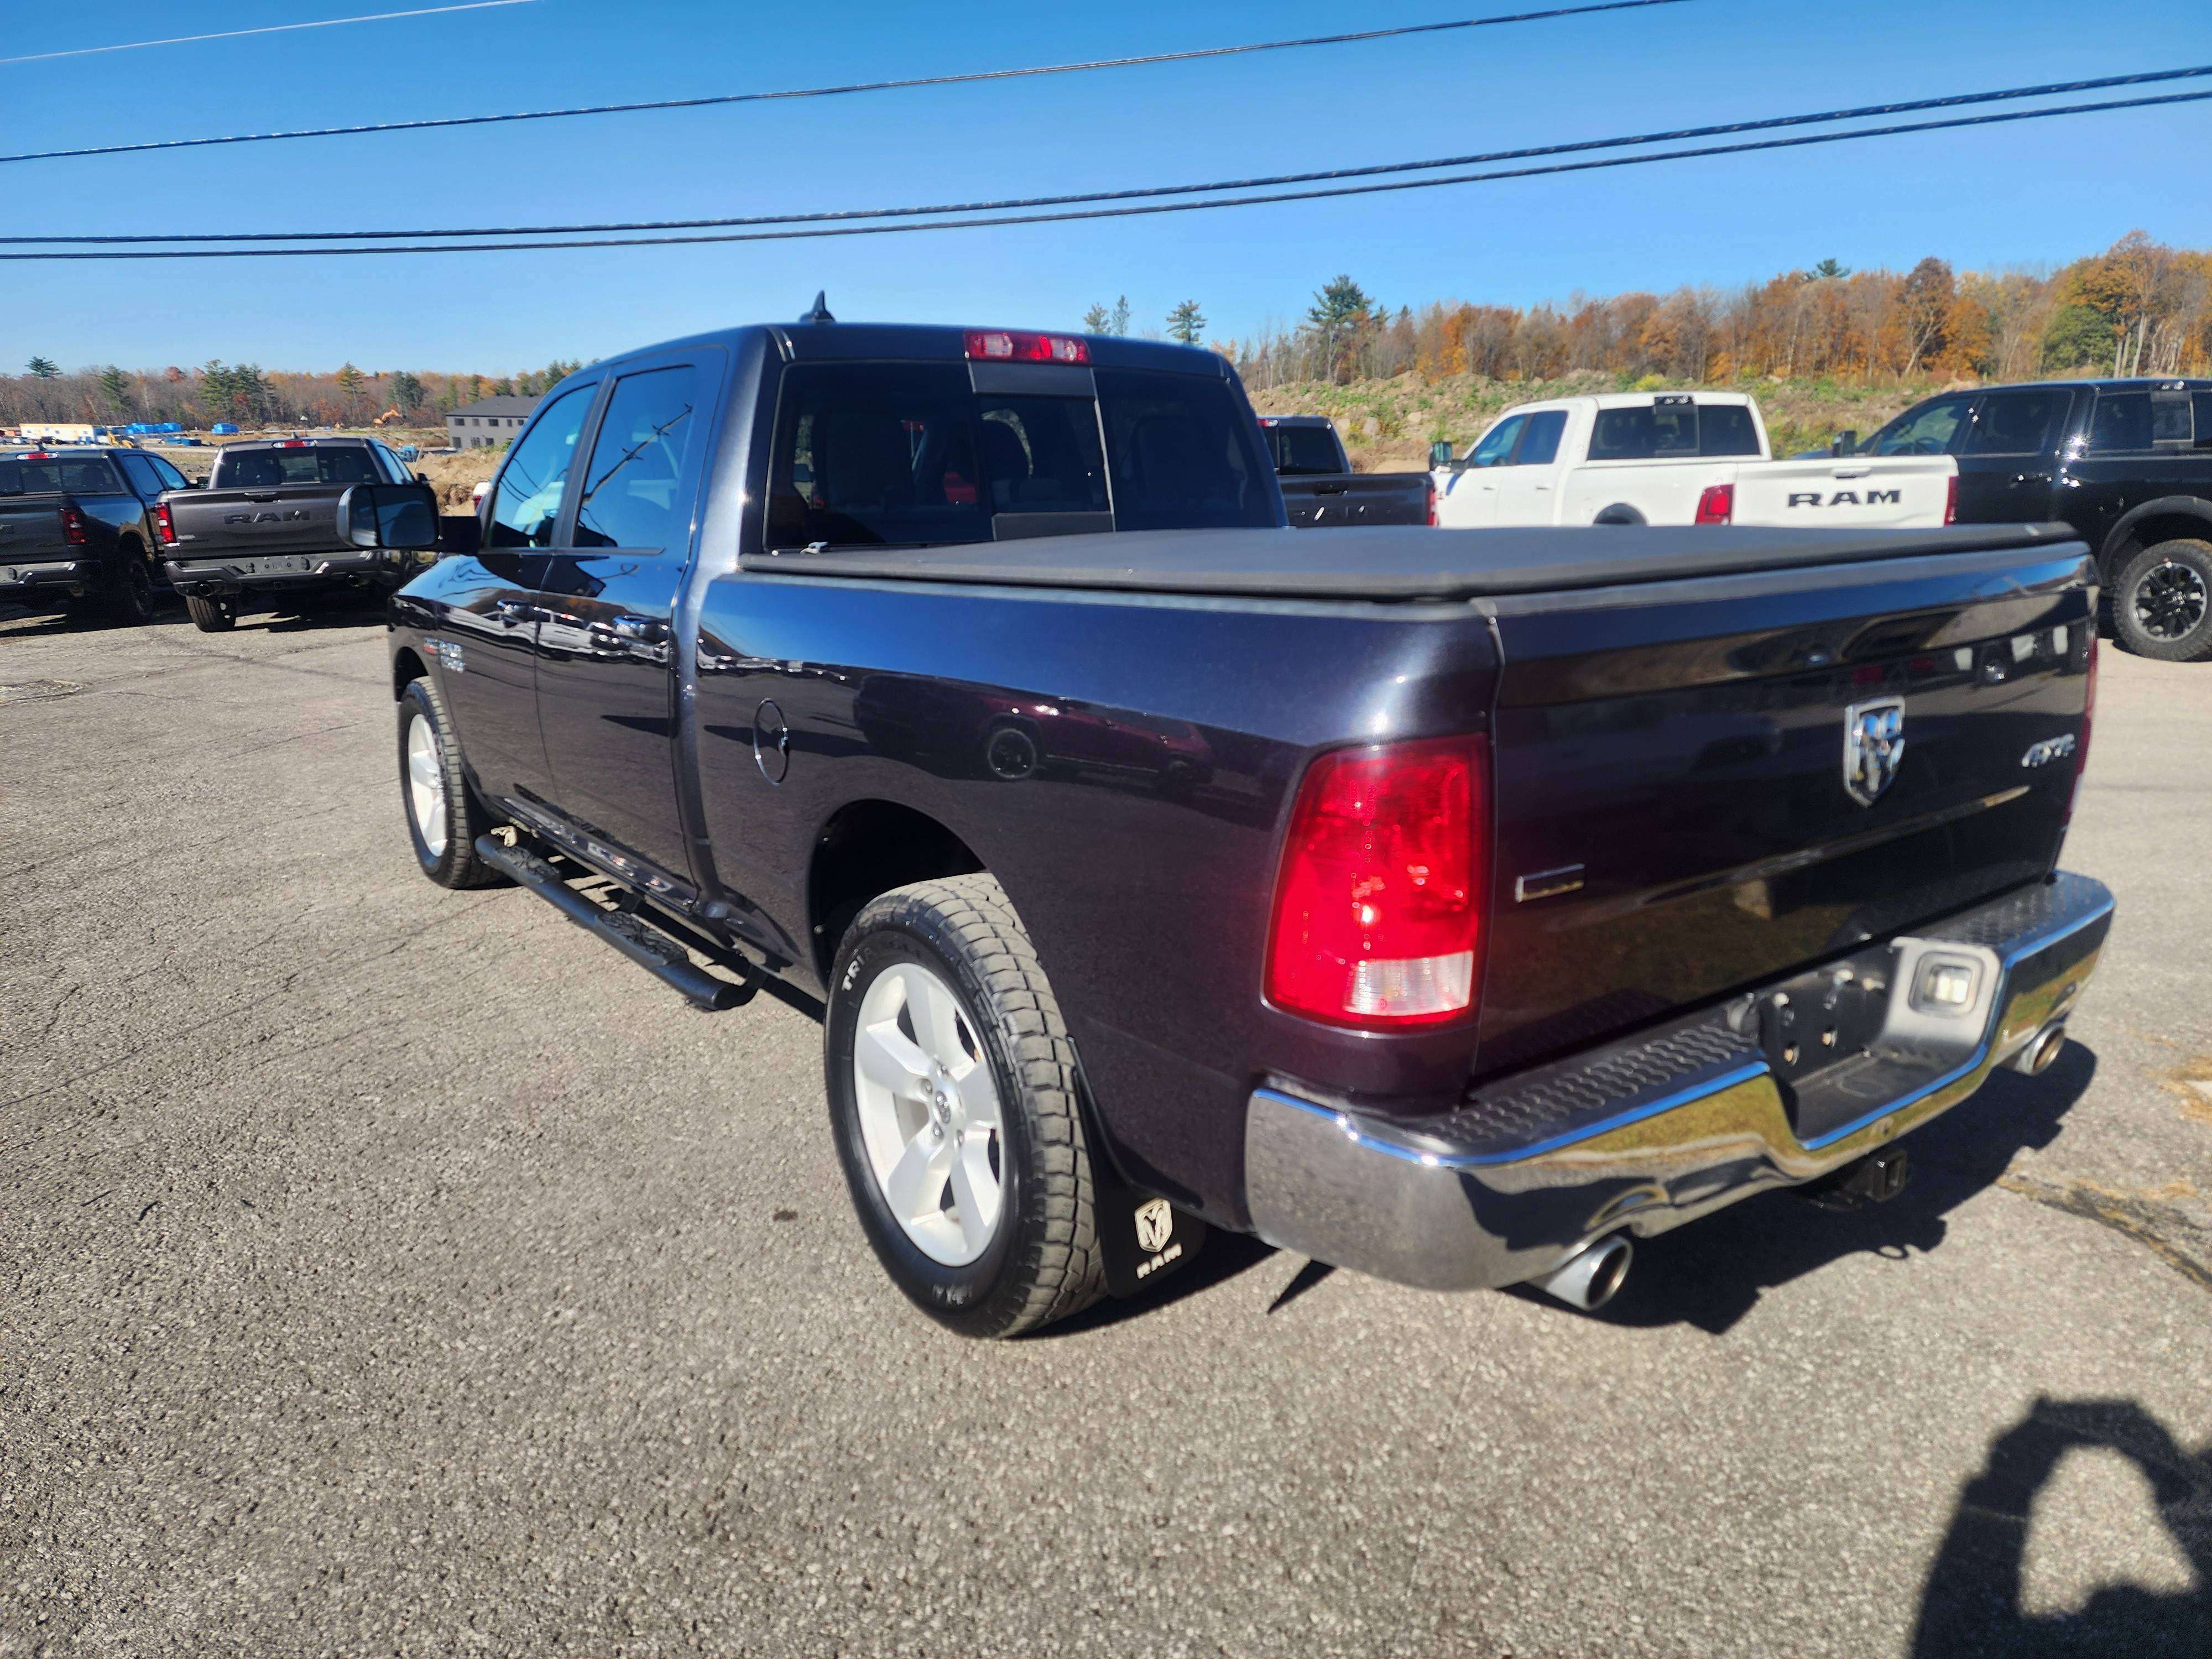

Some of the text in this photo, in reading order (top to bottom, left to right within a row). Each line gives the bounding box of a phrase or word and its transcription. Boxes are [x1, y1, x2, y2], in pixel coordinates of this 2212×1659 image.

[1788, 489, 1901, 507] RAM
[223, 510, 310, 524] RAM
[1136, 1243, 1182, 1279] RAM
